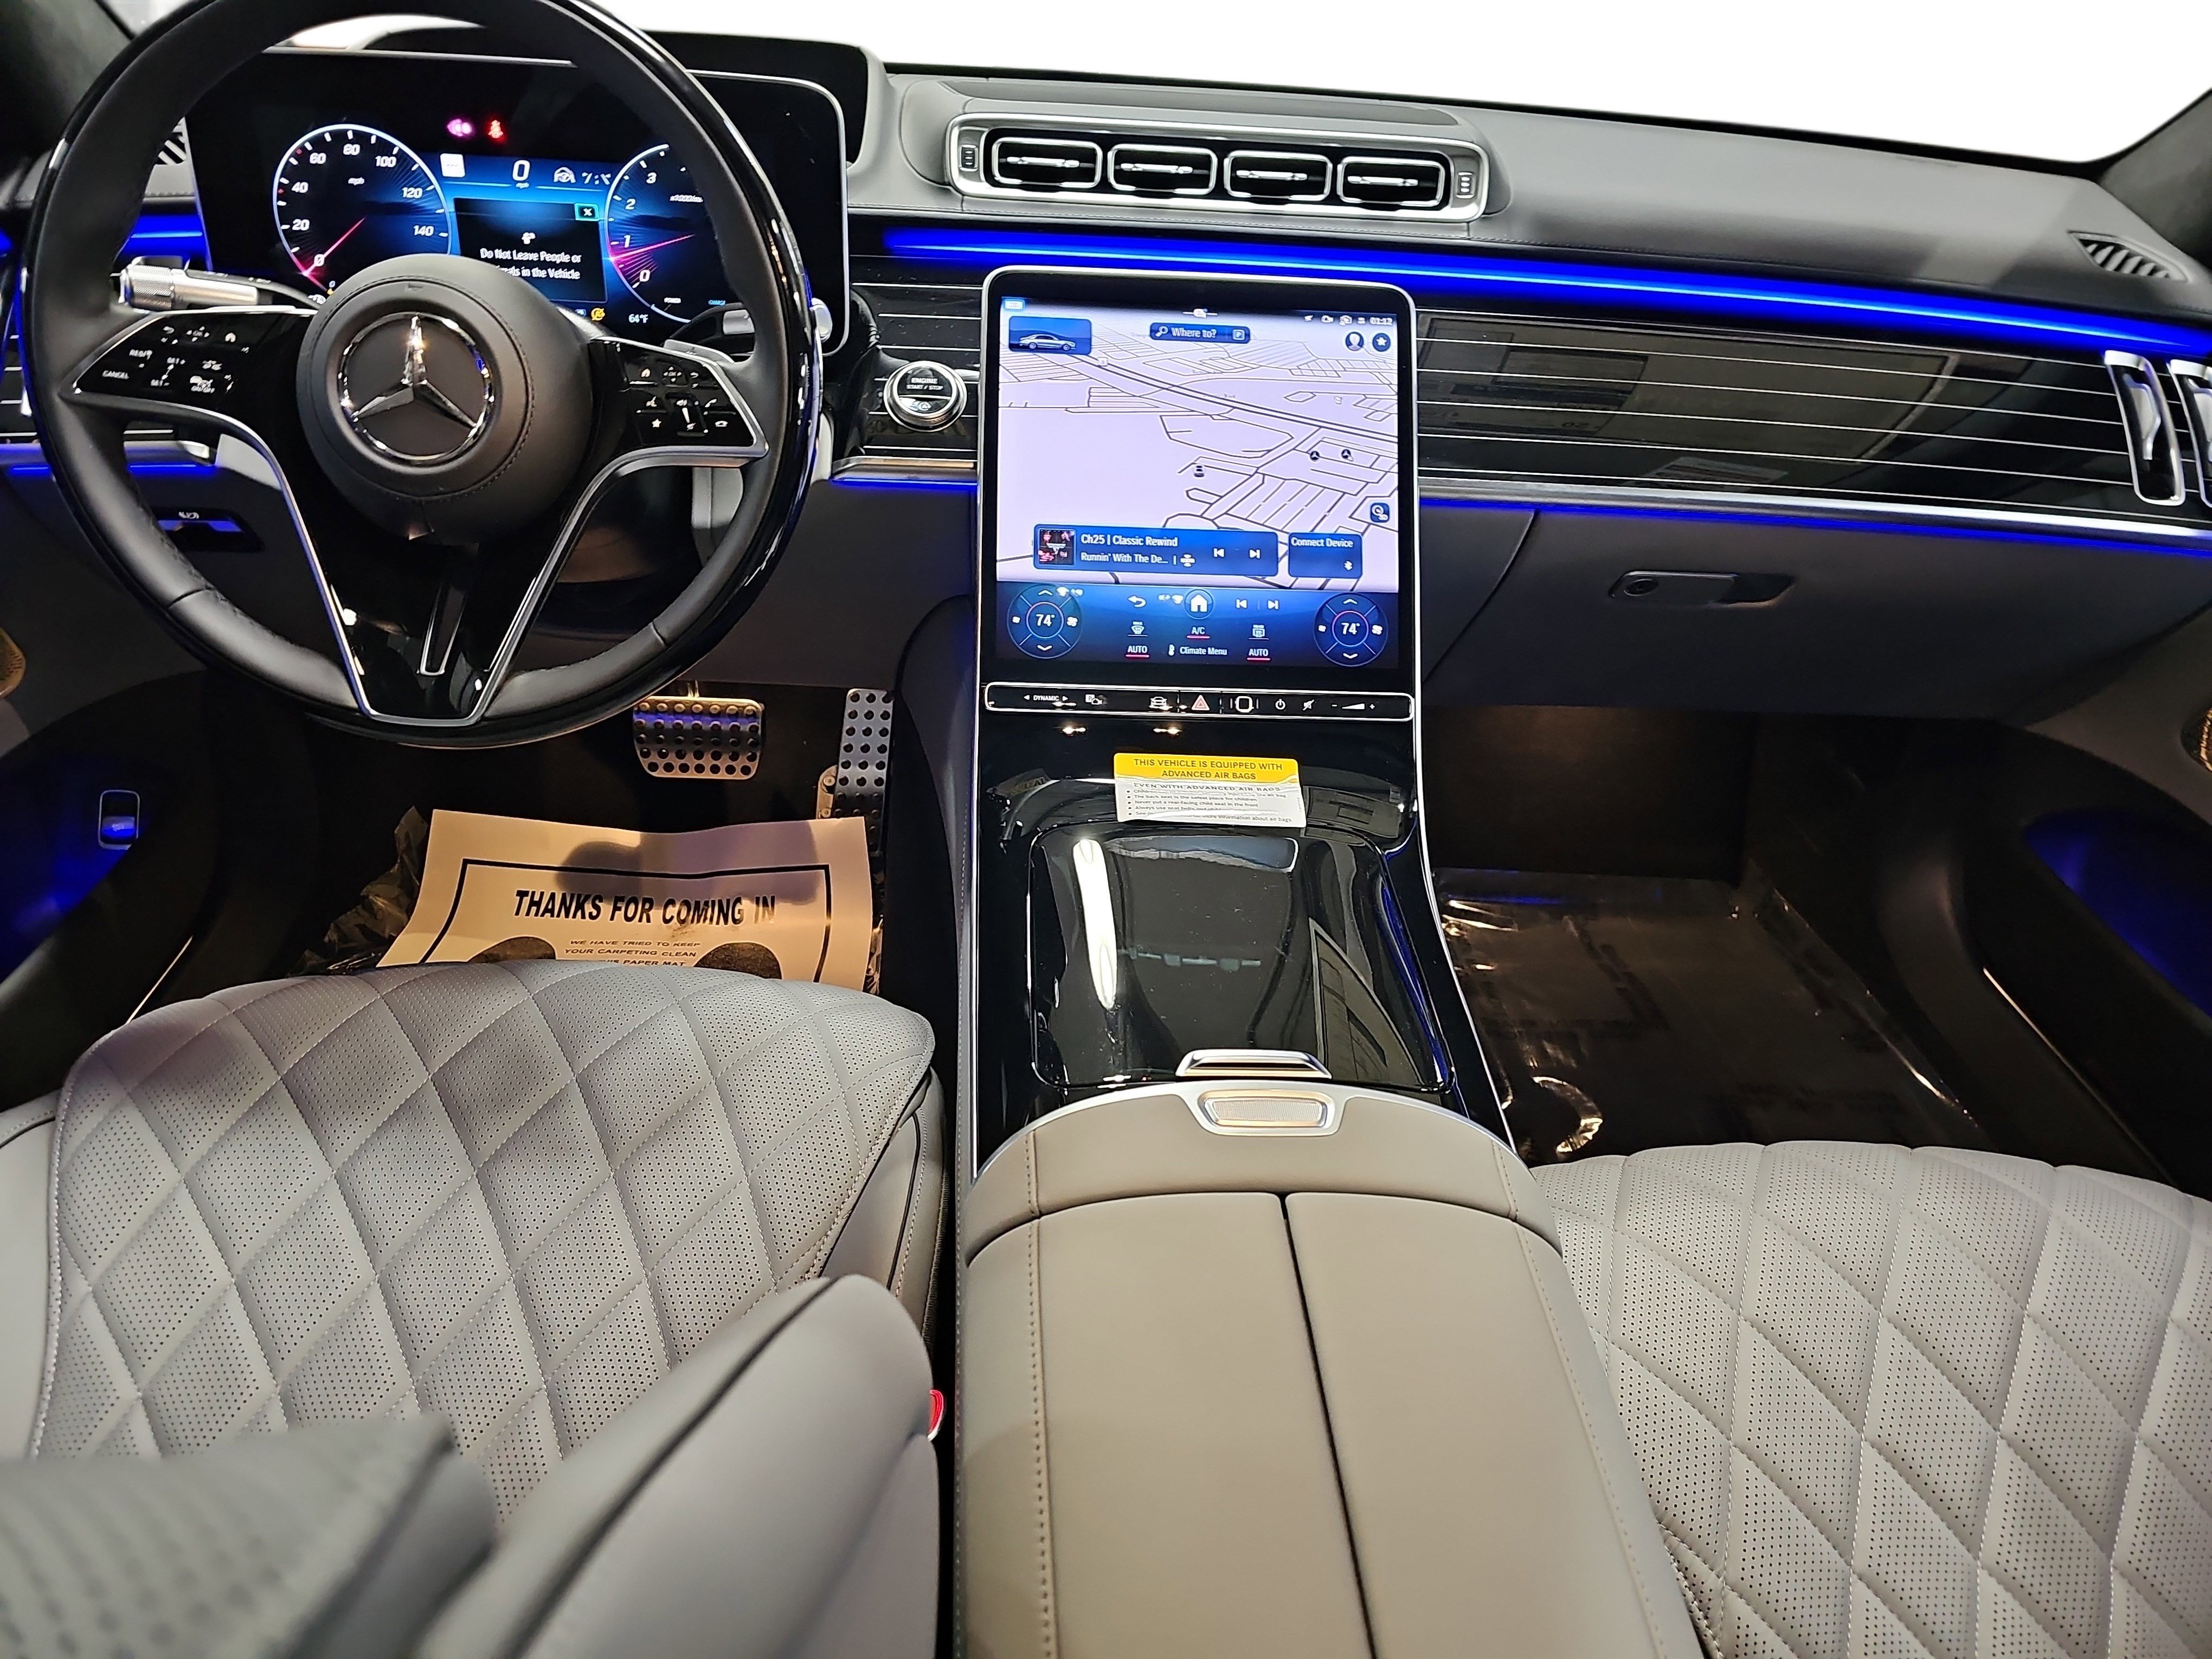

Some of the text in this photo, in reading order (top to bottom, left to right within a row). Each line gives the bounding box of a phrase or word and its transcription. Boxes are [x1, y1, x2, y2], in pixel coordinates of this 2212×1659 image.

[343, 144, 360, 156] 80
[310, 152, 326, 164] 60
[375, 156, 396, 168] 100
[512, 159, 530, 182] 0
[646, 172, 657, 184] 3
[291, 182, 309, 193] 40
[402, 187, 423, 199] 120
[625, 198, 636, 210] 2
[292, 219, 310, 231] 20
[413, 225, 434, 237] 140
[623, 234, 631, 248] 1
[314, 254, 324, 267] 0
[480, 248, 582, 263] Do Not Leave People or
[520, 266, 531, 276] in
[531, 267, 547, 278] the
[547, 268, 581, 280] Vehicle
[639, 269, 651, 282] 0
[1171, 326, 1200, 338] Where
[1202, 329, 1217, 339] to?
[1081, 533, 1105, 545] Ch25
[1112, 535, 1143, 546] Classic
[1145, 536, 1178, 547] Rewind
[1291, 537, 1354, 548] Connect Device
[1113, 553, 1133, 563] With
[1134, 554, 1149, 563] The
[1191, 626, 1205, 635] A/C
[1127, 645, 1148, 654] AUTO
[1180, 646, 1227, 656] Climate Menu
[1249, 648, 1269, 657] AUTO
[1134, 758, 1155, 767] THIS
[1158, 759, 1197, 768] VEHICLE
[1211, 761, 1256, 770] EQUIPPED
[1258, 763, 1283, 771] WITH
[1161, 770, 1212, 779] ADVANCED
[514, 889, 776, 926] THANKS FOR COMING IN
